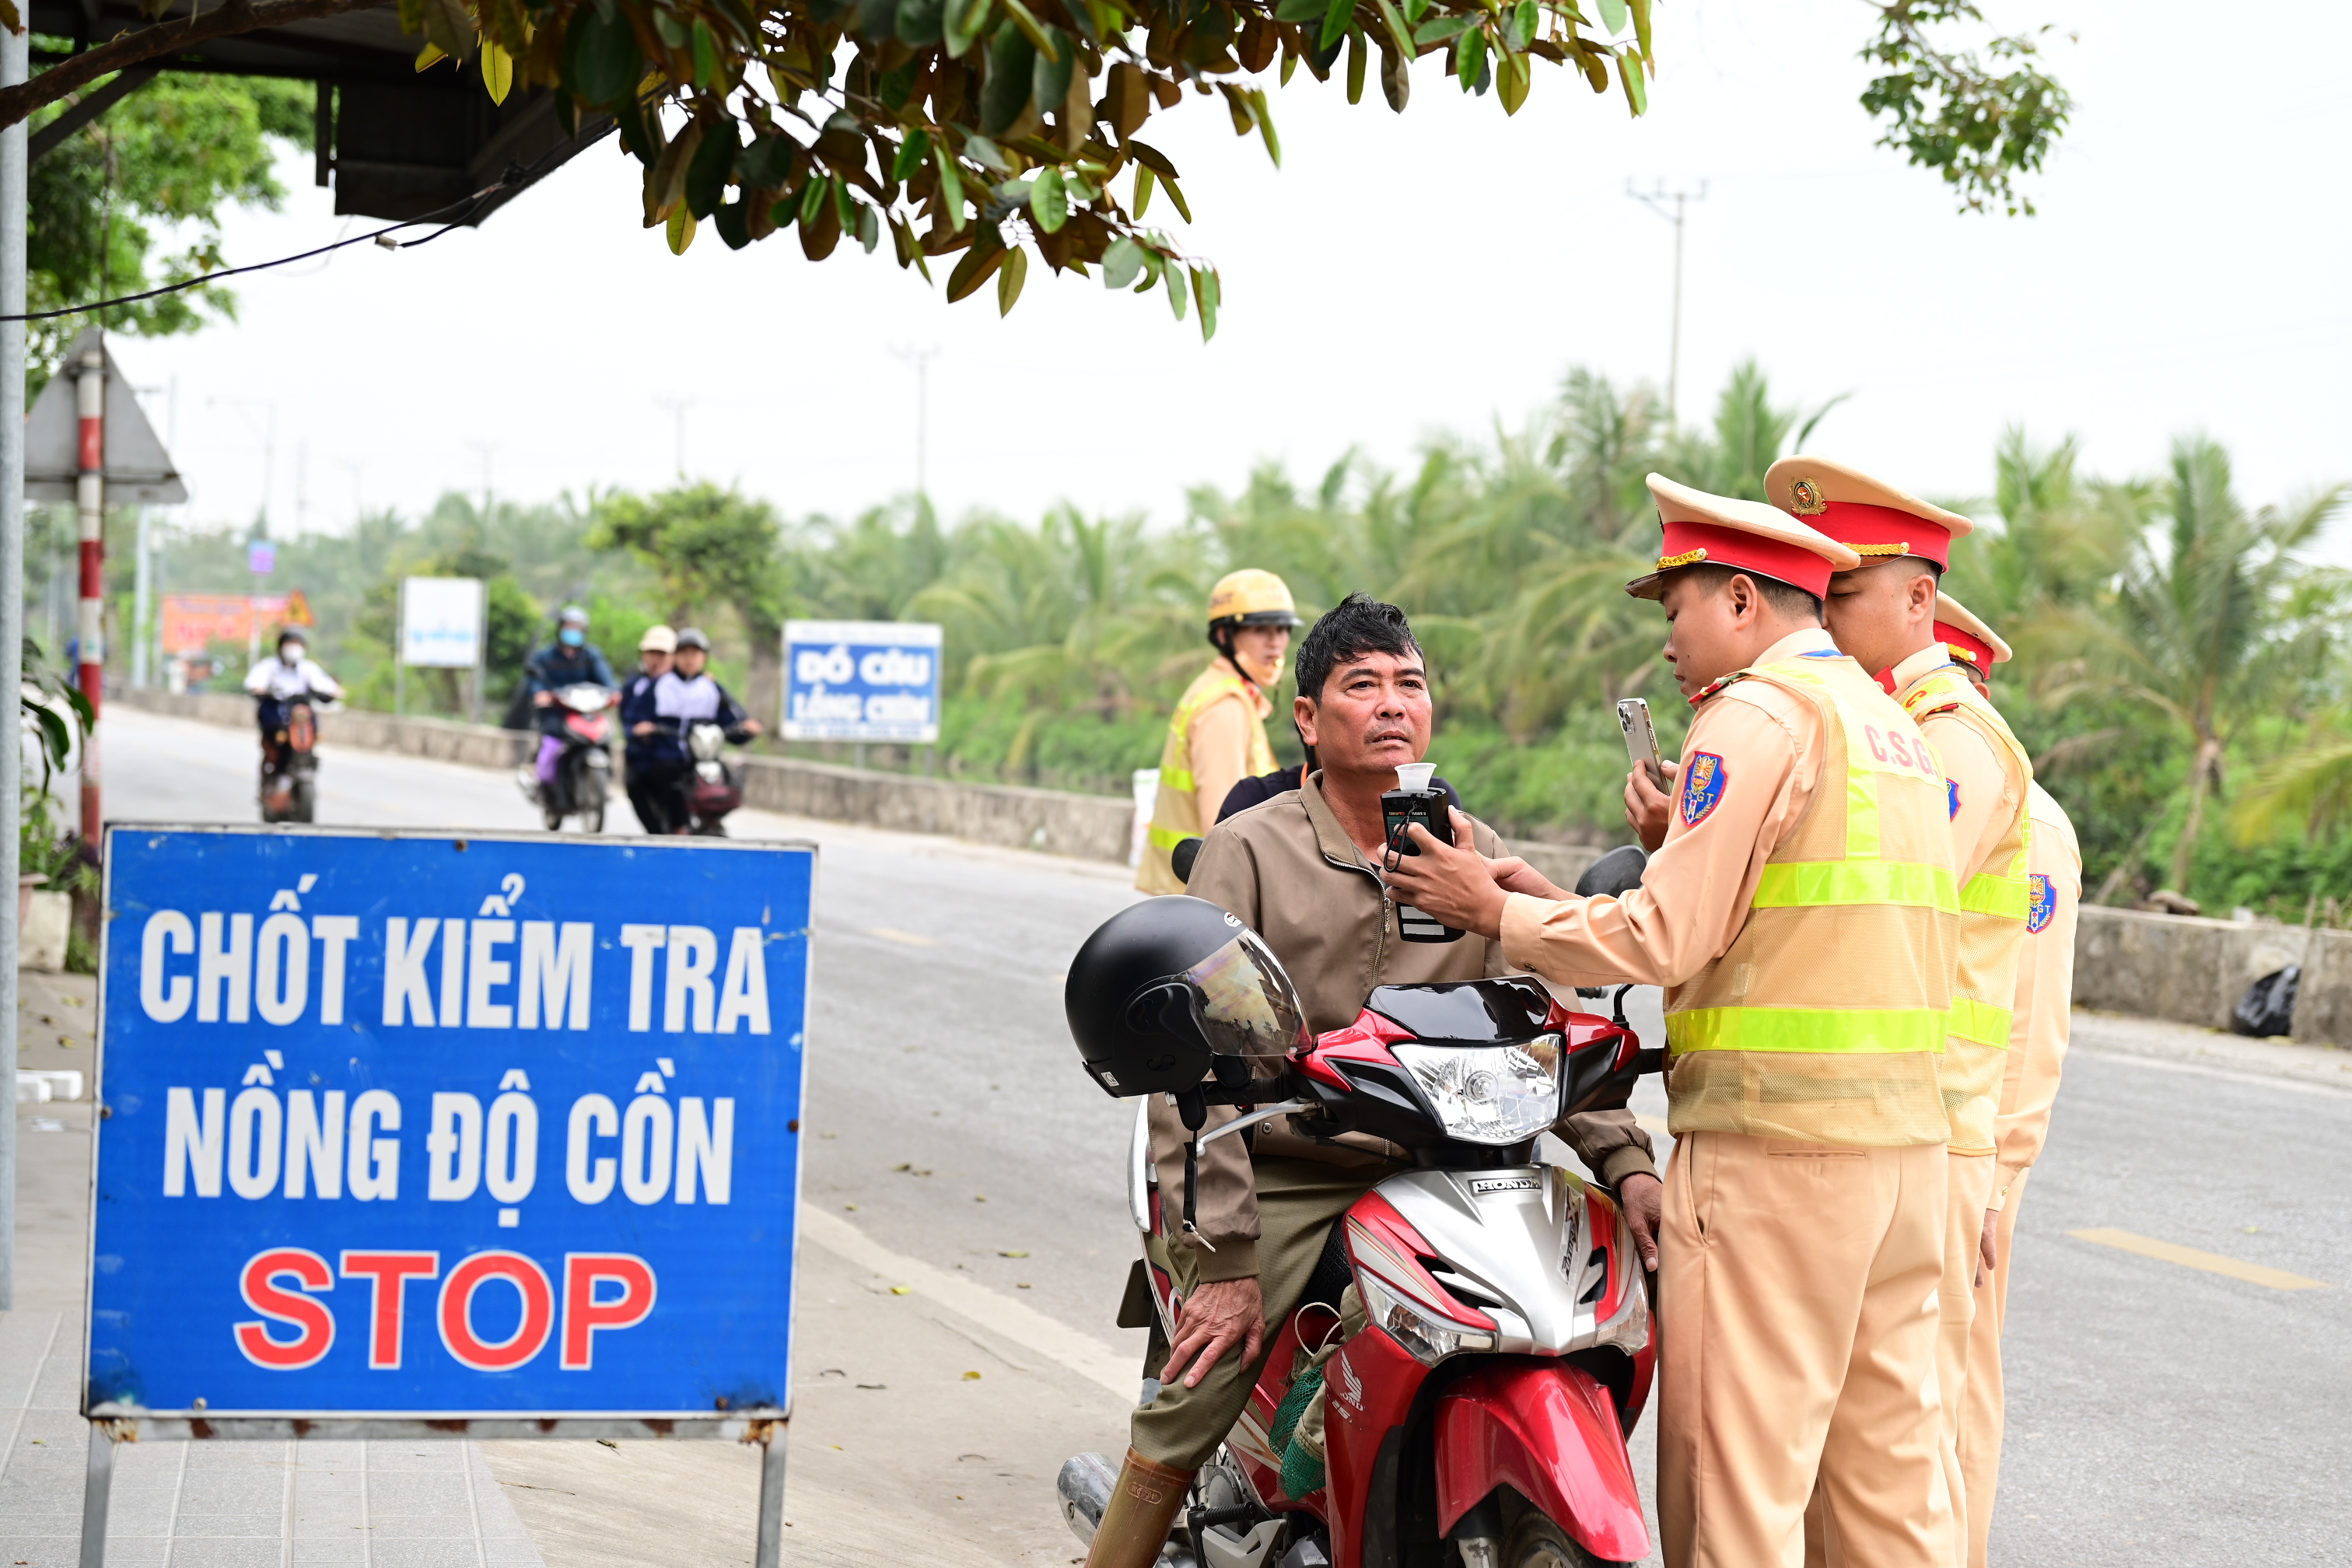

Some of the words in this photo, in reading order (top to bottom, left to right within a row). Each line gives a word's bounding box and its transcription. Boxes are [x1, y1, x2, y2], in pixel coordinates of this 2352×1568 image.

[140, 873, 359, 1025] CHỐT
[383, 873, 593, 1031] KIỂM
[621, 922, 772, 1034] TRA
[163, 1050, 401, 1201] NỒNG
[427, 1069, 538, 1227] ĐỘ
[566, 1058, 735, 1205] CỒN
[233, 1247, 657, 1371] STOP
